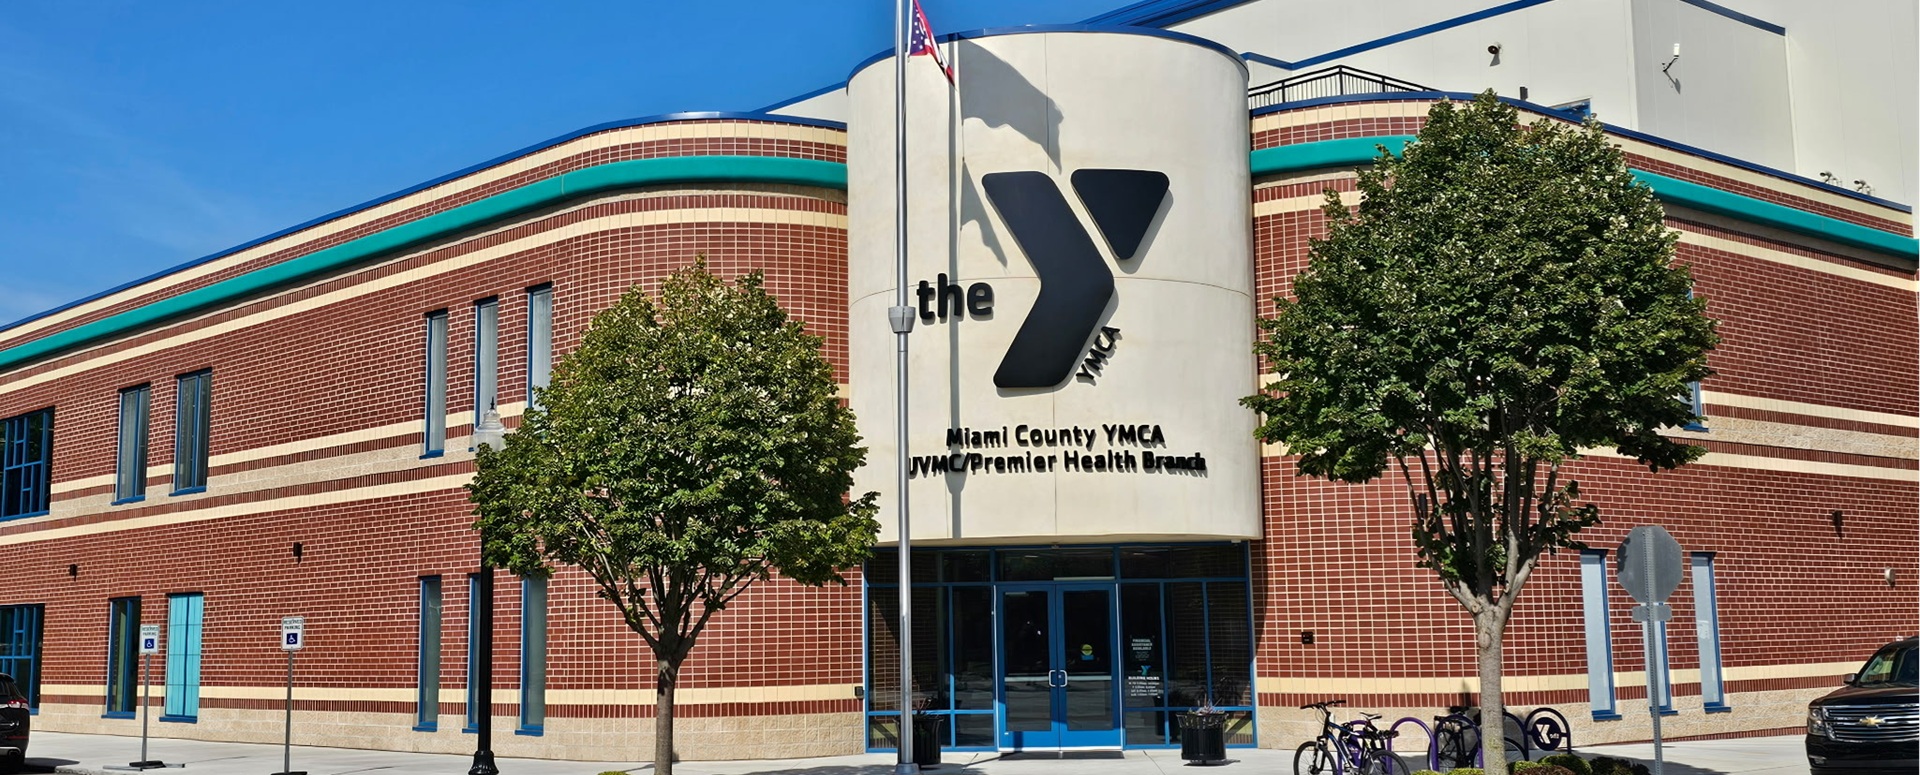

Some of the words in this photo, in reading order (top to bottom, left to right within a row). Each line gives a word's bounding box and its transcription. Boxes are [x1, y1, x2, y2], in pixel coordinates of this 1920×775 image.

[916, 273, 994, 320] the
[1076, 325, 1121, 380] YMCA
[946, 425, 1008, 448] Miami
[1015, 424, 1095, 448] County
[1102, 424, 1165, 446] YMCA
[1064, 450, 1136, 472] Health
[1142, 451, 1207, 472] Branch
